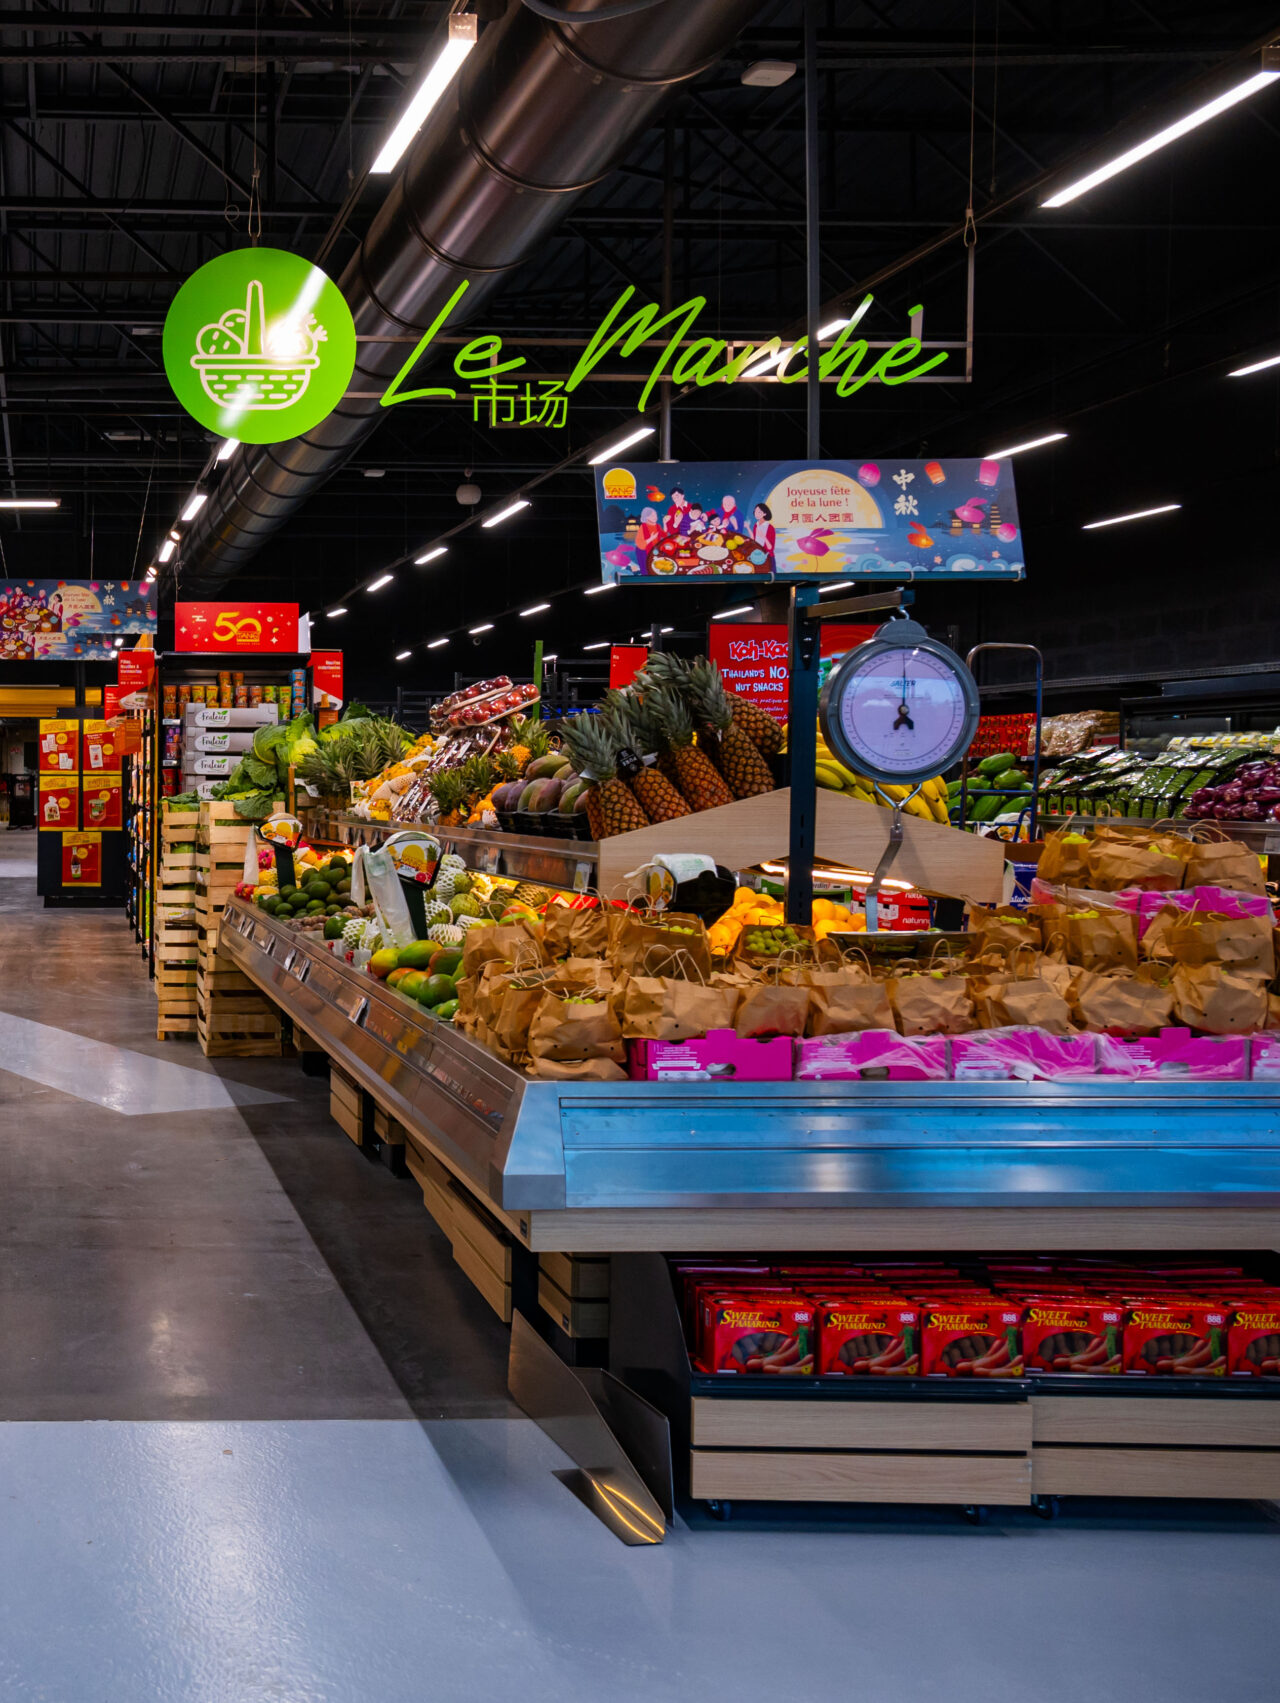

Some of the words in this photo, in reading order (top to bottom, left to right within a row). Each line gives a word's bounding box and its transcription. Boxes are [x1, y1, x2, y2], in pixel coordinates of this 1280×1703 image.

[380, 279, 526, 406] Le
[565, 285, 949, 412] Marché
[470, 377, 569, 429] 市场
[787, 487, 827, 498] Joyeuse
[830, 485, 851, 496] fête
[892, 468, 919, 516] 中秋
[790, 497, 804, 508] de
[807, 497, 816, 507] la
[819, 497, 842, 507] lune
[212, 611, 262, 641] 50
[722, 668, 765, 679] THAILAND'S
[769, 666, 790, 679] NO.
[735, 683, 751, 692] NUT
[753, 682, 784, 693] SNACKS
[720, 1310, 763, 1325] SWEET
[827, 1312, 869, 1328] SWEET
[928, 1313, 970, 1328] SWEET
[1027, 1309, 1070, 1323] SWEET
[1129, 1311, 1174, 1326] SWEET
[1233, 1312, 1277, 1327] SWEET
[730, 1319, 779, 1329] TAMARIND
[837, 1321, 886, 1331] TAMARIND
[939, 1321, 988, 1332] TAMARIND
[1037, 1318, 1087, 1328] TAMARIND
[1140, 1320, 1191, 1330] TAMARIND
[1244, 1321, 1280, 1330] TAMARI
